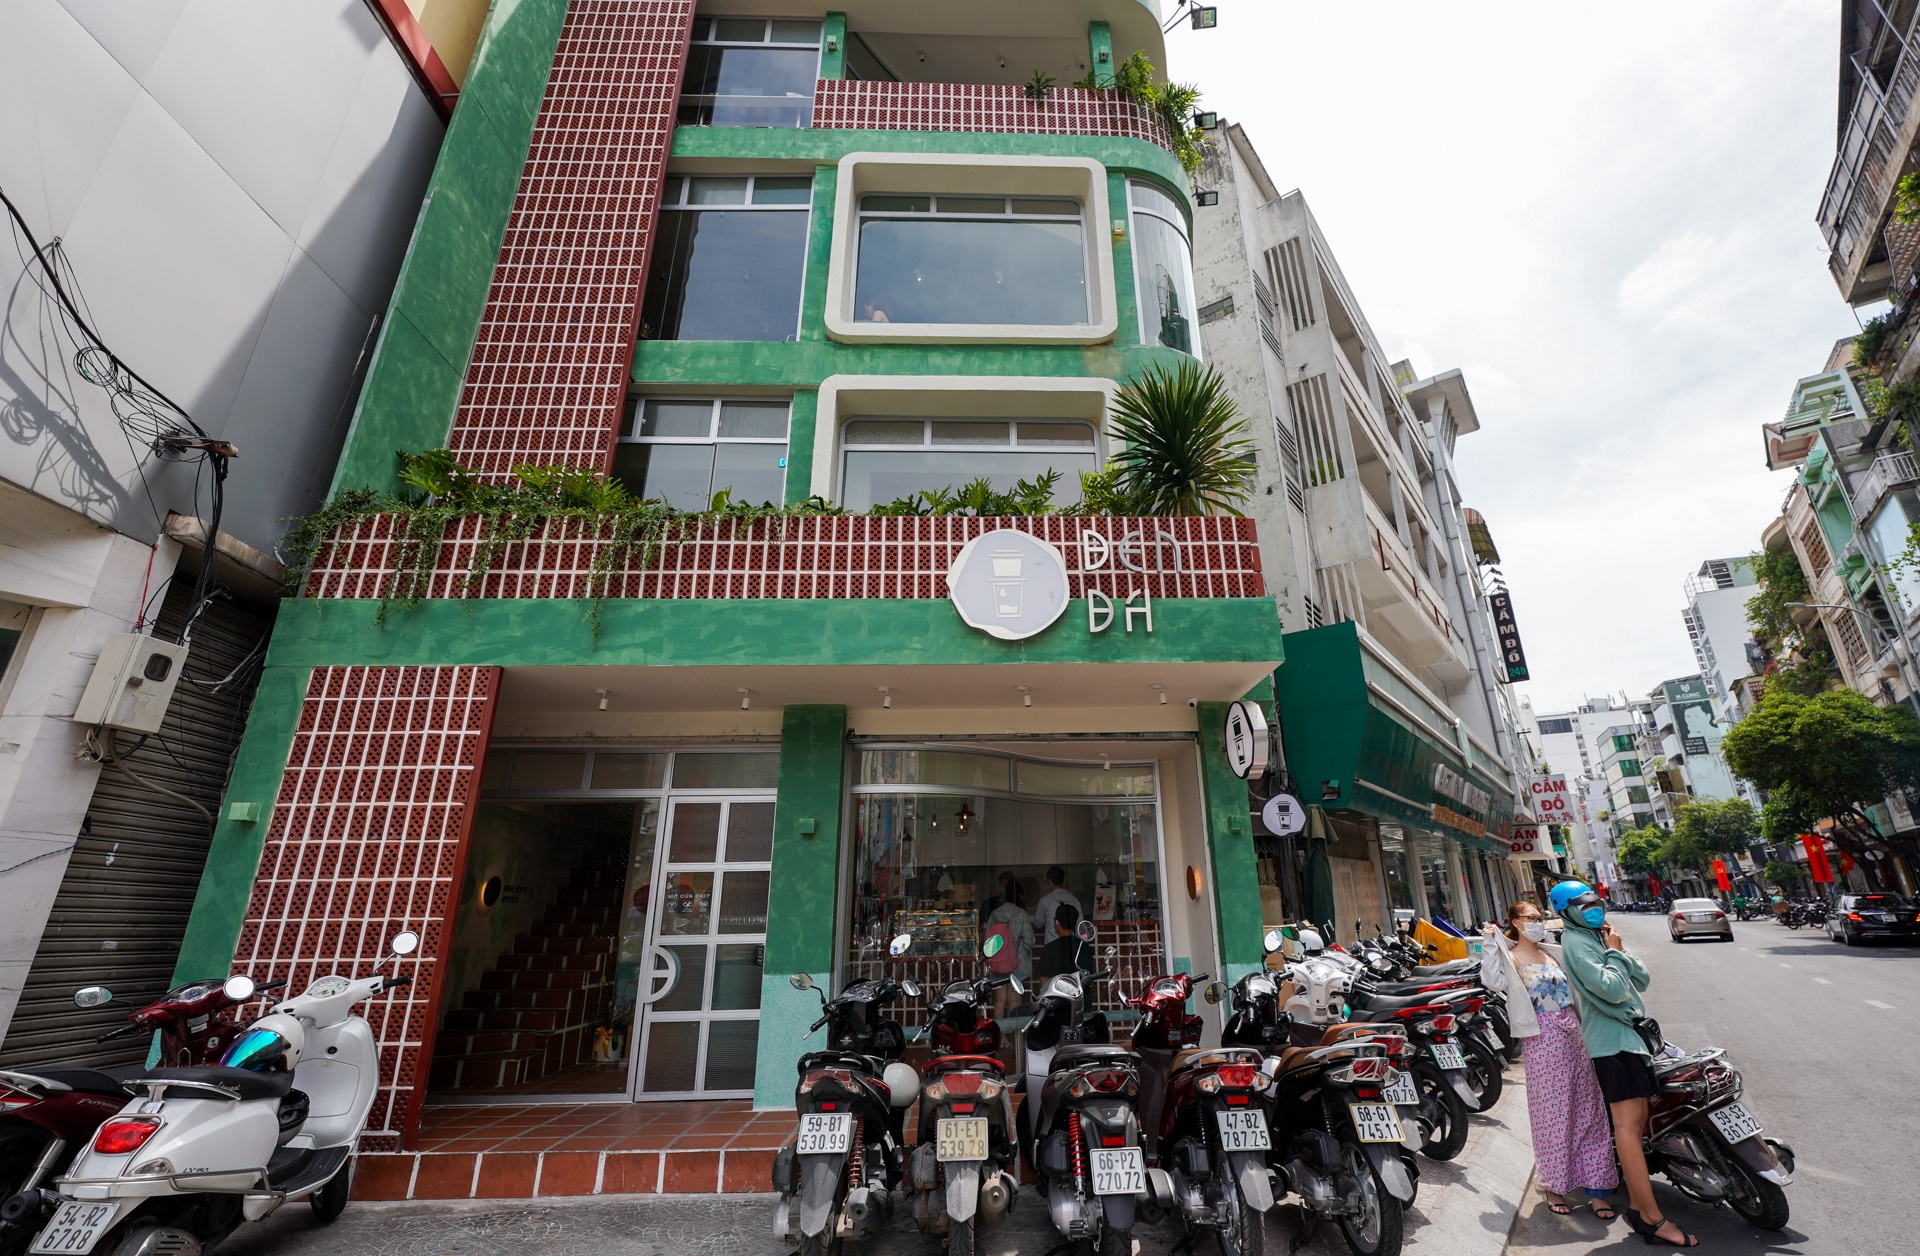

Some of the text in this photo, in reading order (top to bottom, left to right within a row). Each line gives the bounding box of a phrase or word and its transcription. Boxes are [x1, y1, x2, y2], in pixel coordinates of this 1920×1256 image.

[1508, 666, 1528, 677] 24h
[1531, 776, 1567, 794] CẦM
[1541, 794, 1565, 811] ĐỒ
[1539, 813, 1556, 823] 2.5%
[1561, 811, 1573, 821] 3%
[1510, 827, 1538, 839] ẦM
[1510, 840, 1534, 852] ĐỒ
[1226, 1113, 1260, 1129] 47-B2
[1357, 1106, 1391, 1121] 68-G1
[1714, 1104, 1745, 1125] 59-S3
[808, 1116, 842, 1132] 59-B1
[945, 1121, 979, 1138] 61-E1
[1358, 1123, 1401, 1139] 745.11
[1723, 1117, 1760, 1140] 361.32
[800, 1134, 846, 1150] 530.99
[1224, 1130, 1268, 1148] 787.25
[940, 1140, 985, 1157] 539.28
[1098, 1152, 1136, 1170] 66-P2
[1097, 1172, 1142, 1191] 270.72
[58, 1206, 108, 1226] 54-R2
[43, 1228, 93, 1250] 6788
